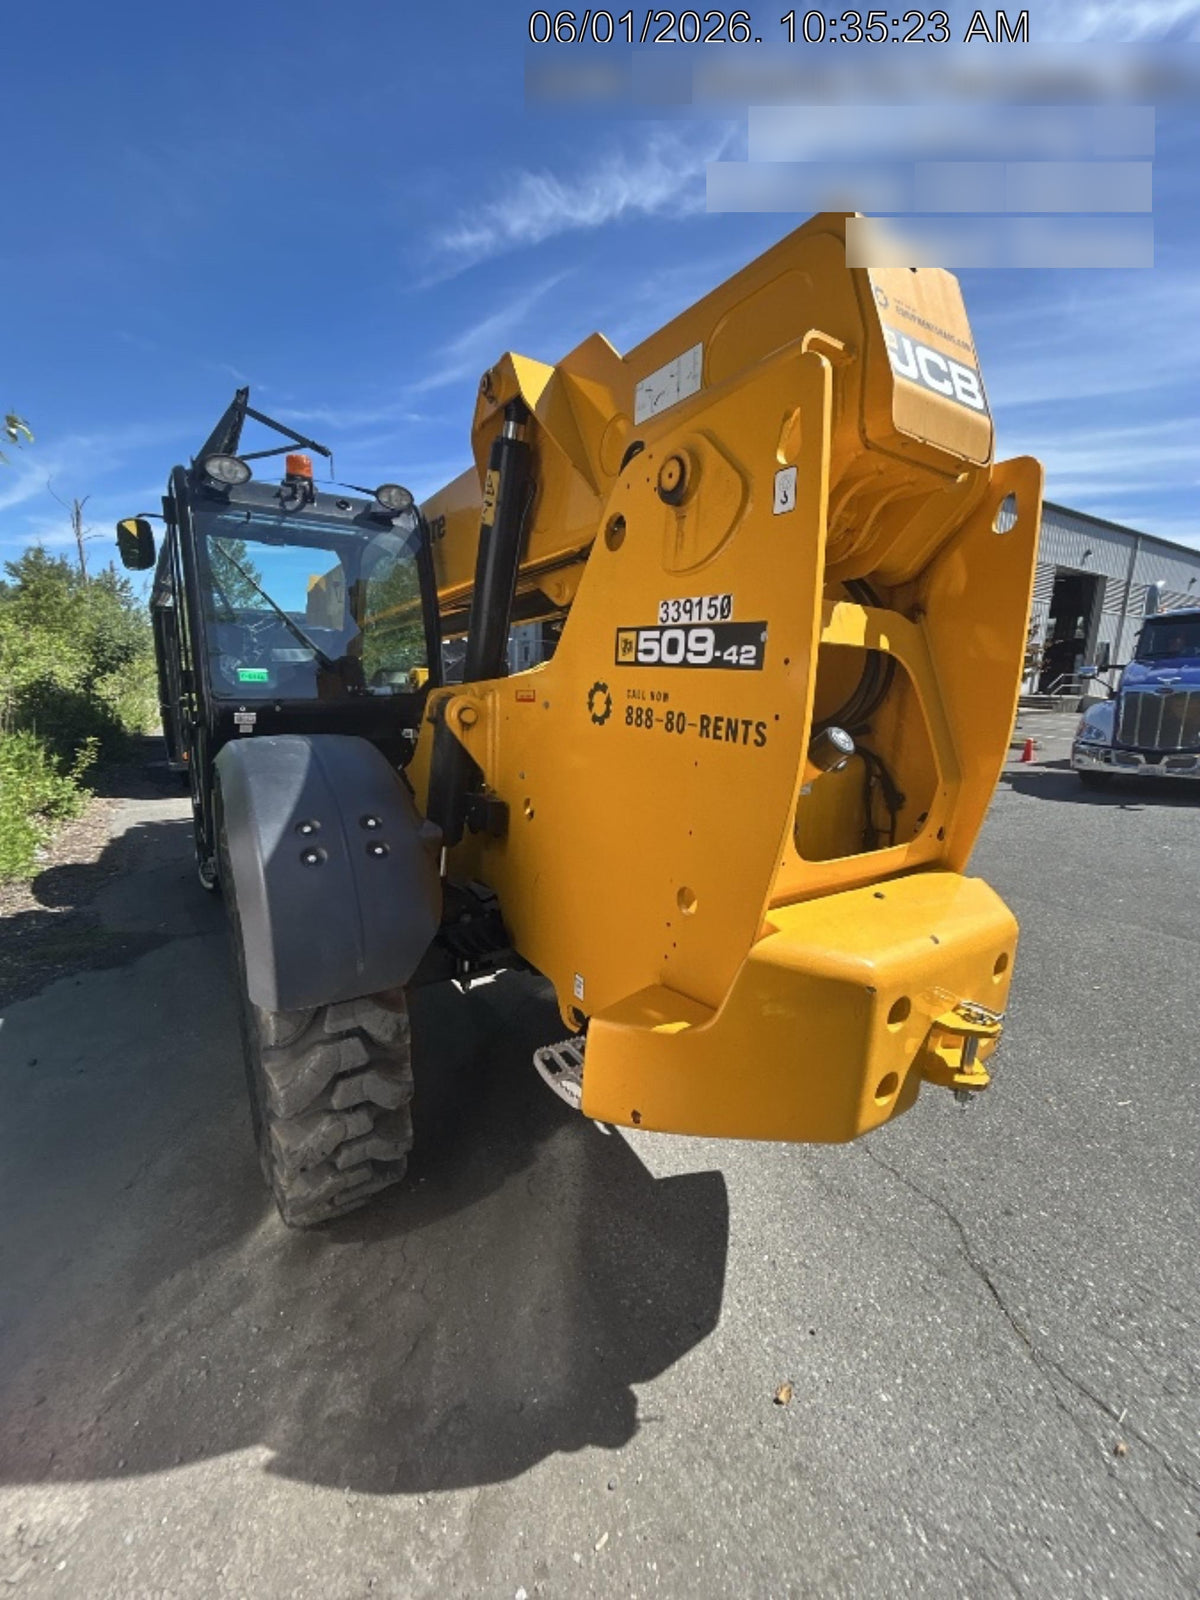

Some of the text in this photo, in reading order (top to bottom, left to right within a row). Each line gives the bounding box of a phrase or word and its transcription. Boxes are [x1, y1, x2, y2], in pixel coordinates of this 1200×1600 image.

[889, 336, 984, 410] JCB
[659, 594, 732, 624] 339150
[637, 627, 757, 666] 509-42
[625, 705, 767, 747] 888-80-RENTS
